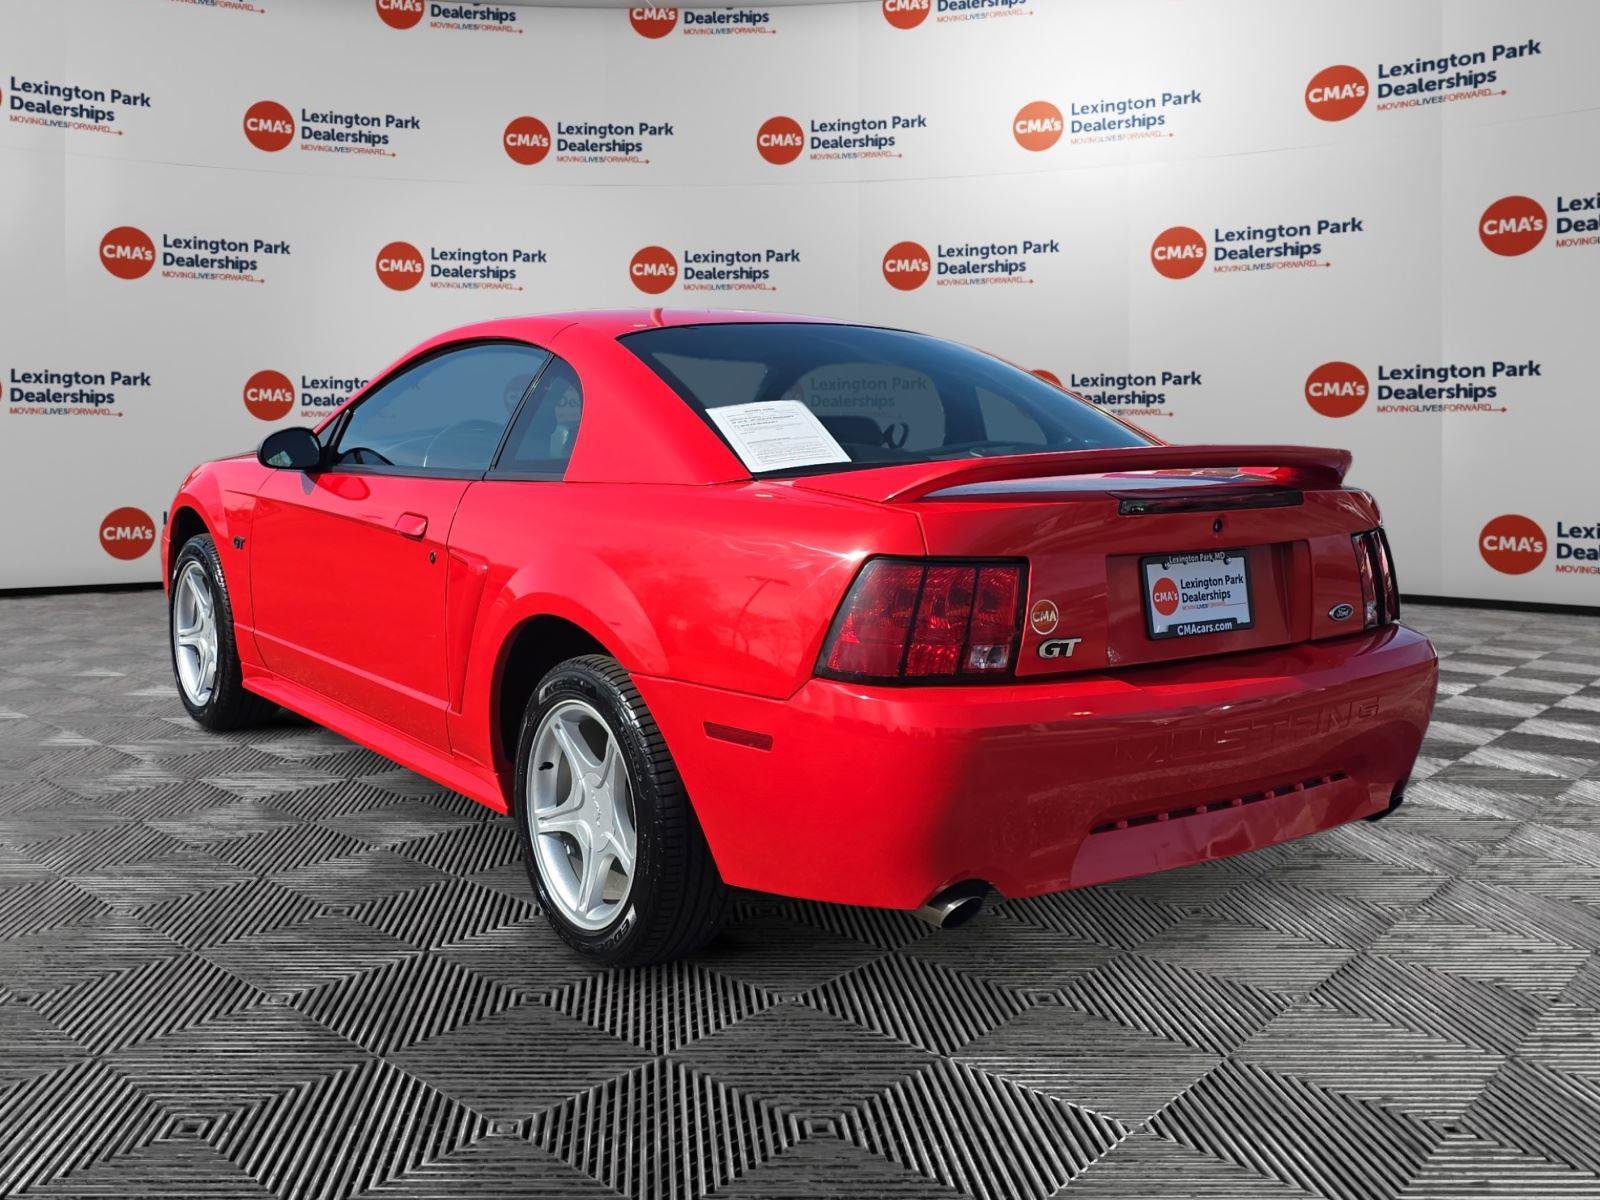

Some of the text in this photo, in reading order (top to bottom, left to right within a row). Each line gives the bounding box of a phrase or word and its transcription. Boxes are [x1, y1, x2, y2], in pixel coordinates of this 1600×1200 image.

[430, 4, 516, 24] Dealerships
[633, 8, 675, 20] CMA's
[684, 10, 769, 26] Dealerships
[1378, 40, 1541, 80] Lexington Park
[11, 76, 150, 107] Lexington Park
[1378, 68, 1496, 99] Dealerships
[1309, 83, 1365, 102] CMA's
[10, 96, 114, 122] Dealerships
[1072, 90, 1200, 119] Lexington Park
[247, 118, 292, 134] CMA's
[302, 109, 420, 129] Lexington Park
[811, 115, 926, 136] Lexington Park
[1016, 118, 1061, 133] CMA's
[1072, 114, 1164, 133] Dealerships
[302, 126, 388, 146] Dealerships
[558, 122, 673, 138] Lexington Park
[506, 134, 548, 146] CMA's
[558, 139, 642, 155] Dealerships
[760, 134, 801, 146] CMA's
[811, 134, 895, 152] Dealerships
[1215, 218, 1363, 244] Lexington Park
[1484, 216, 1543, 234] CMA's
[103, 245, 152, 260] CMA's
[164, 234, 290, 255] Lexington Park
[938, 240, 1059, 262] Lexington Park
[1154, 245, 1203, 260] CMA's
[1215, 242, 1321, 262] Dealerships
[163, 252, 257, 273] Dealerships
[432, 248, 546, 265] Lexington Park
[685, 248, 800, 266] Lexington Park
[379, 259, 422, 272] CMA's
[431, 264, 516, 282] Dealerships
[633, 264, 675, 278] CMA's
[886, 259, 928, 272] CMA's
[938, 260, 1026, 275] Dealerships
[684, 267, 769, 282] Dealerships
[11, 369, 150, 389] Lexington Park
[1072, 372, 1201, 390] Lexington Park
[1378, 360, 1541, 386] Lexington Park
[10, 388, 114, 407] Dealerships
[247, 388, 292, 401] CMA's
[1309, 382, 1364, 396] CMA's
[1378, 383, 1496, 402] Dealerships
[103, 526, 152, 540] CMA's
[1484, 536, 1542, 552] CMA's
[1169, 555, 1198, 564] Lexington
[1180, 574, 1244, 589] Lexington Park
[1153, 591, 1178, 602] CMA's
[1182, 589, 1231, 603] Dealerships
[1032, 610, 1057, 622] CMA
[1177, 622, 1232, 636] CMAcars.com
[1038, 638, 1082, 658] GT
